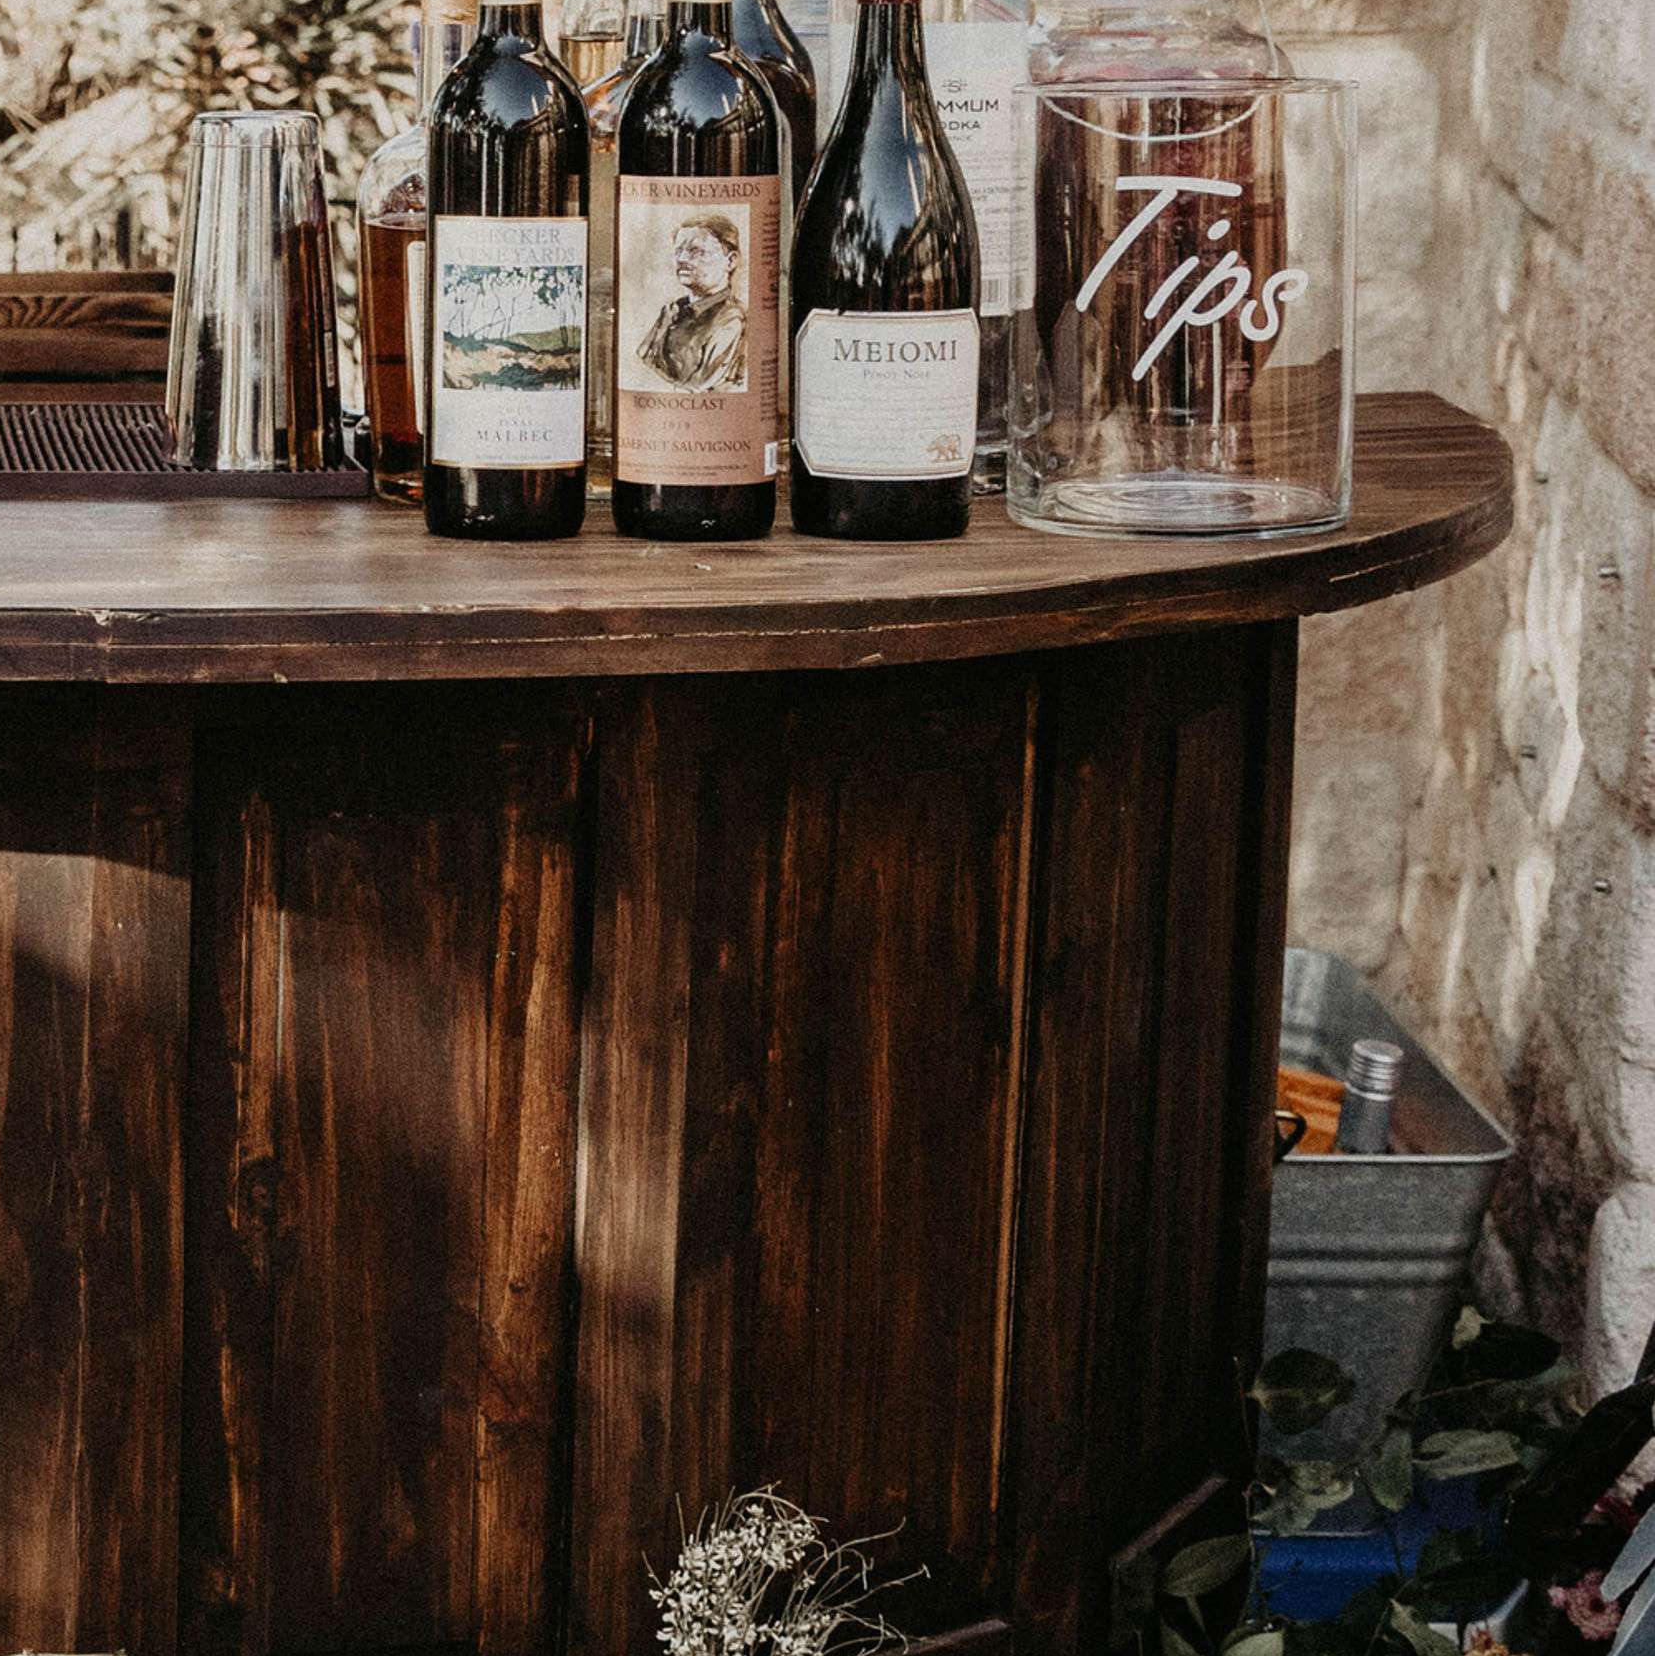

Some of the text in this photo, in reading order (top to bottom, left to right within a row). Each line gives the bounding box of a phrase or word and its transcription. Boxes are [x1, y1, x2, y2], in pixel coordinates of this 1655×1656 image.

[937, 98, 1000, 113] MMUM
[663, 181, 761, 198] VINEYARDS
[1075, 175, 1310, 382] Tips
[832, 337, 958, 364] MEIOMI
[633, 395, 728, 412] ICONOCLAST
[477, 429, 553, 442] MALBEC
[672, 440, 752, 453] SAUVIGNON
